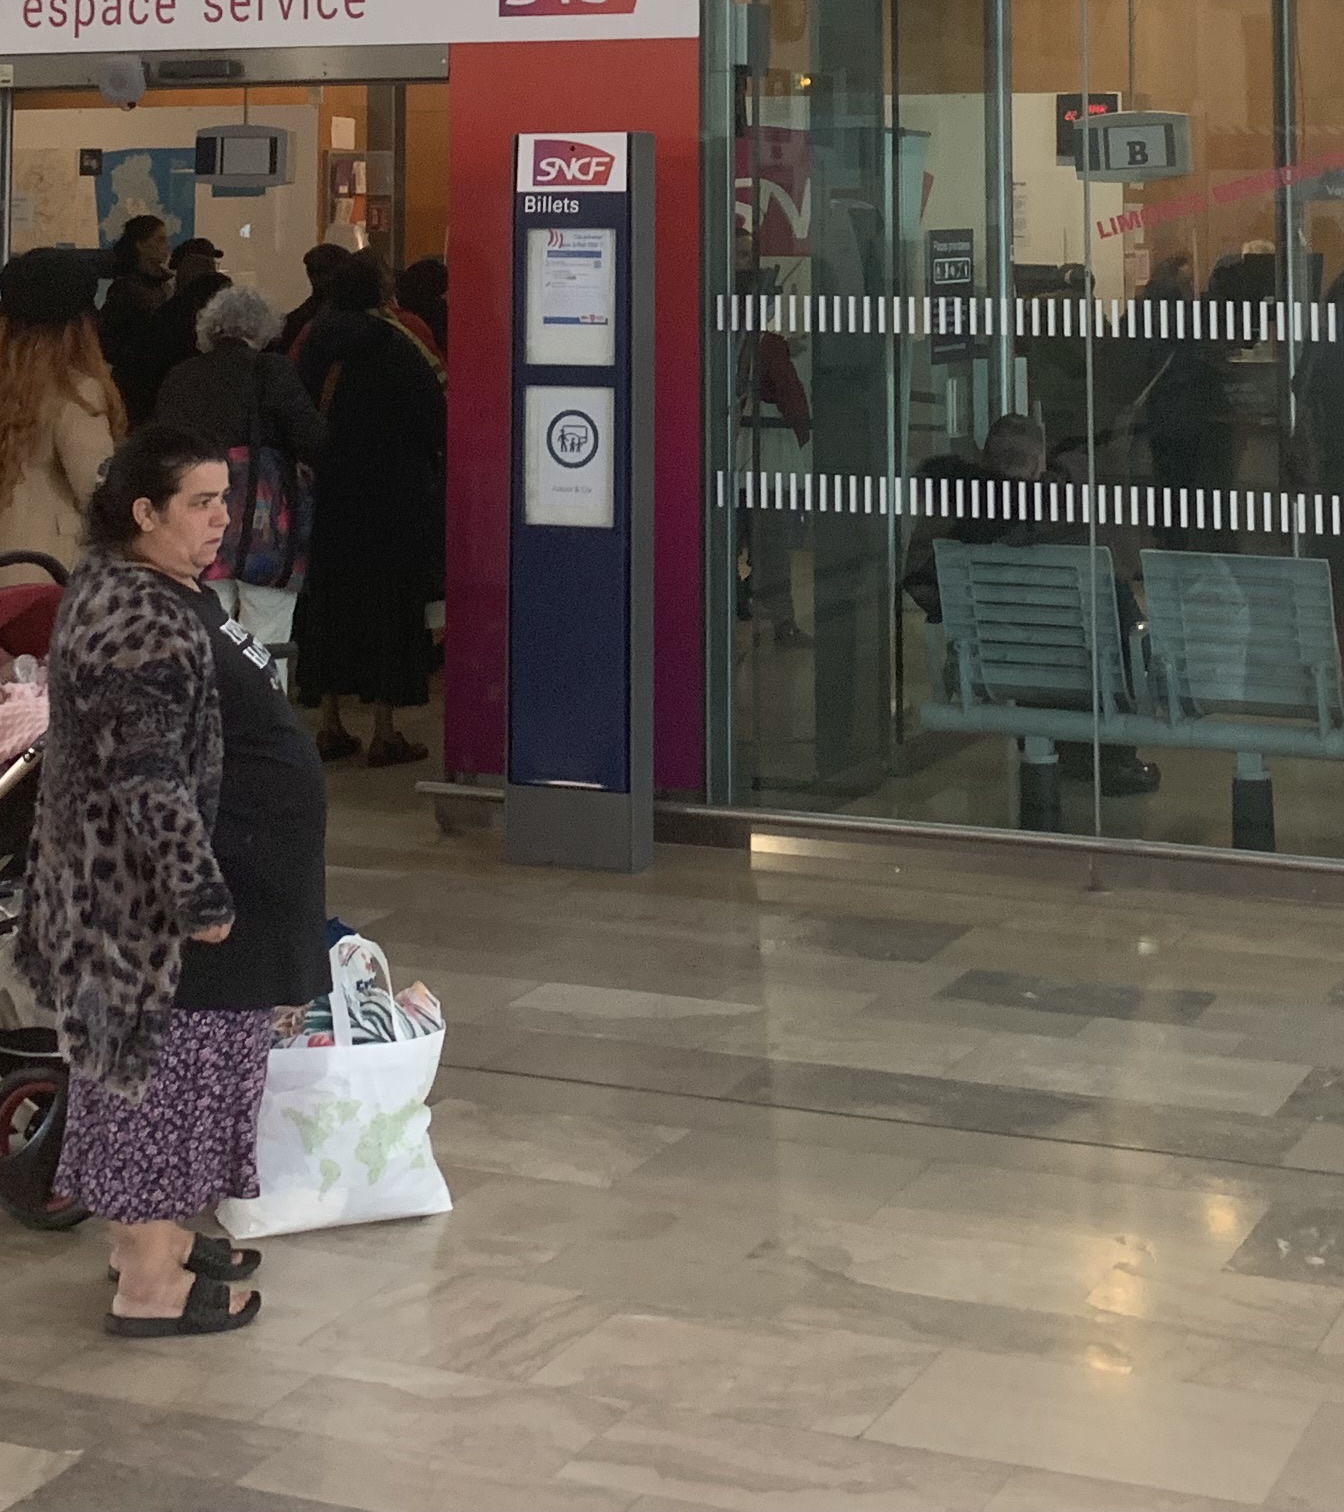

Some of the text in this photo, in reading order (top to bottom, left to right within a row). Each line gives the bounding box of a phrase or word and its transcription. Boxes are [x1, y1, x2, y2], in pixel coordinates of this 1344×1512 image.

[1127, 141, 1149, 165] B
[536, 156, 612, 181] SNCF
[524, 195, 580, 214] Billets
